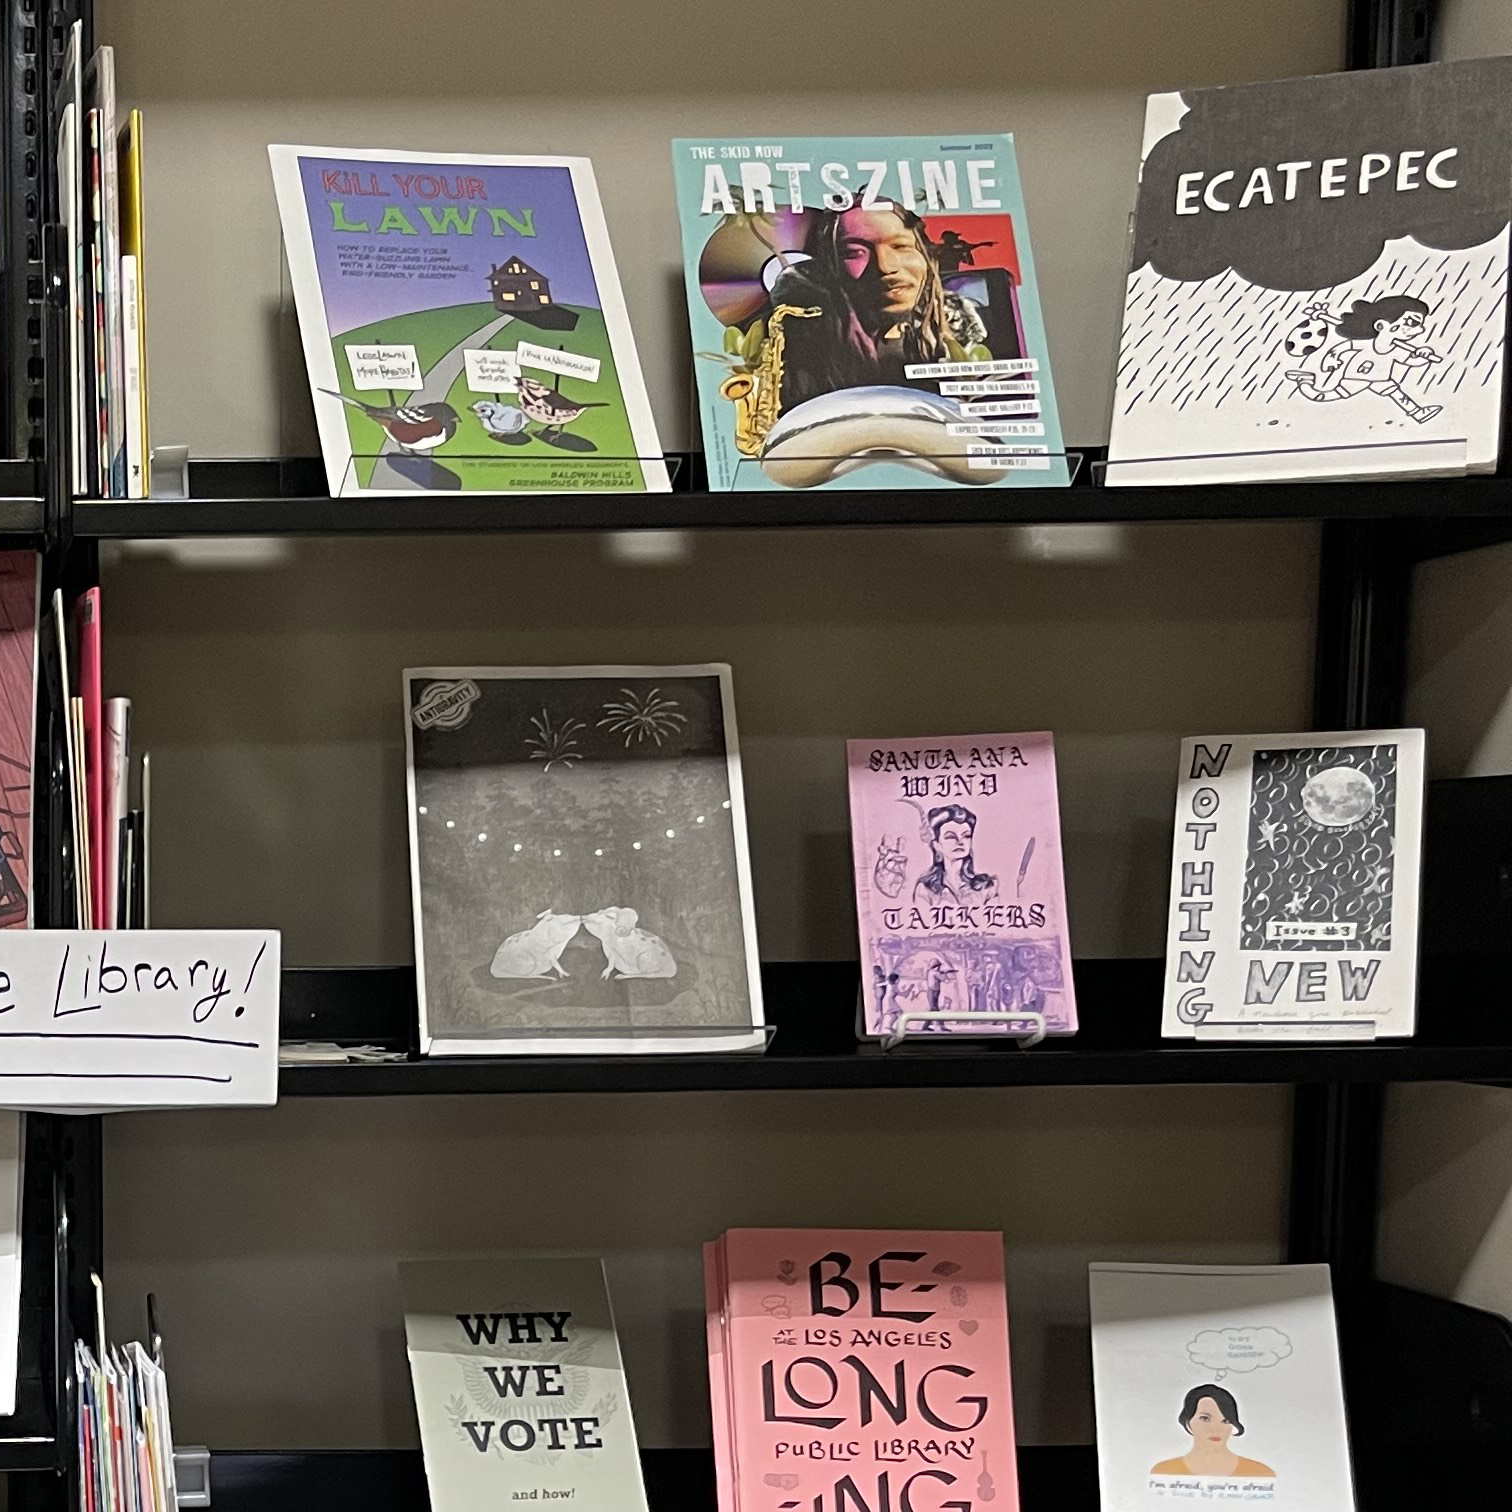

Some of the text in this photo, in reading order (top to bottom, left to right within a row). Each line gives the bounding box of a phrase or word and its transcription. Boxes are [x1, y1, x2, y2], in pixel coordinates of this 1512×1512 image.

[690, 146, 783, 159] THE SKID ROW
[393, 174, 488, 200] YOUR
[1176, 148, 1458, 215] ECATEPEC
[328, 201, 537, 238] LAWN
[418, 685, 473, 724] ANTIGRAVITY
[868, 746, 1028, 772] SANTA ANA
[901, 773, 998, 798] WIND
[1177, 743, 1232, 1024] NOTHING
[881, 903, 1046, 931] TALKERS
[1273, 924, 1317, 937] Issue
[53, 939, 267, 1023] Library!
[1243, 959, 1381, 1005] NEW
[808, 1251, 938, 1324] BE-
[456, 1311, 572, 1345] WHY
[805, 1329, 952, 1350] LOS ANGELES
[483, 1364, 565, 1398] WE
[761, 1354, 989, 1433] LONG
[462, 1417, 603, 1453] VOTE
[874, 1437, 975, 1464] LIBRARY
[512, 1488, 576, 1500] and how!
